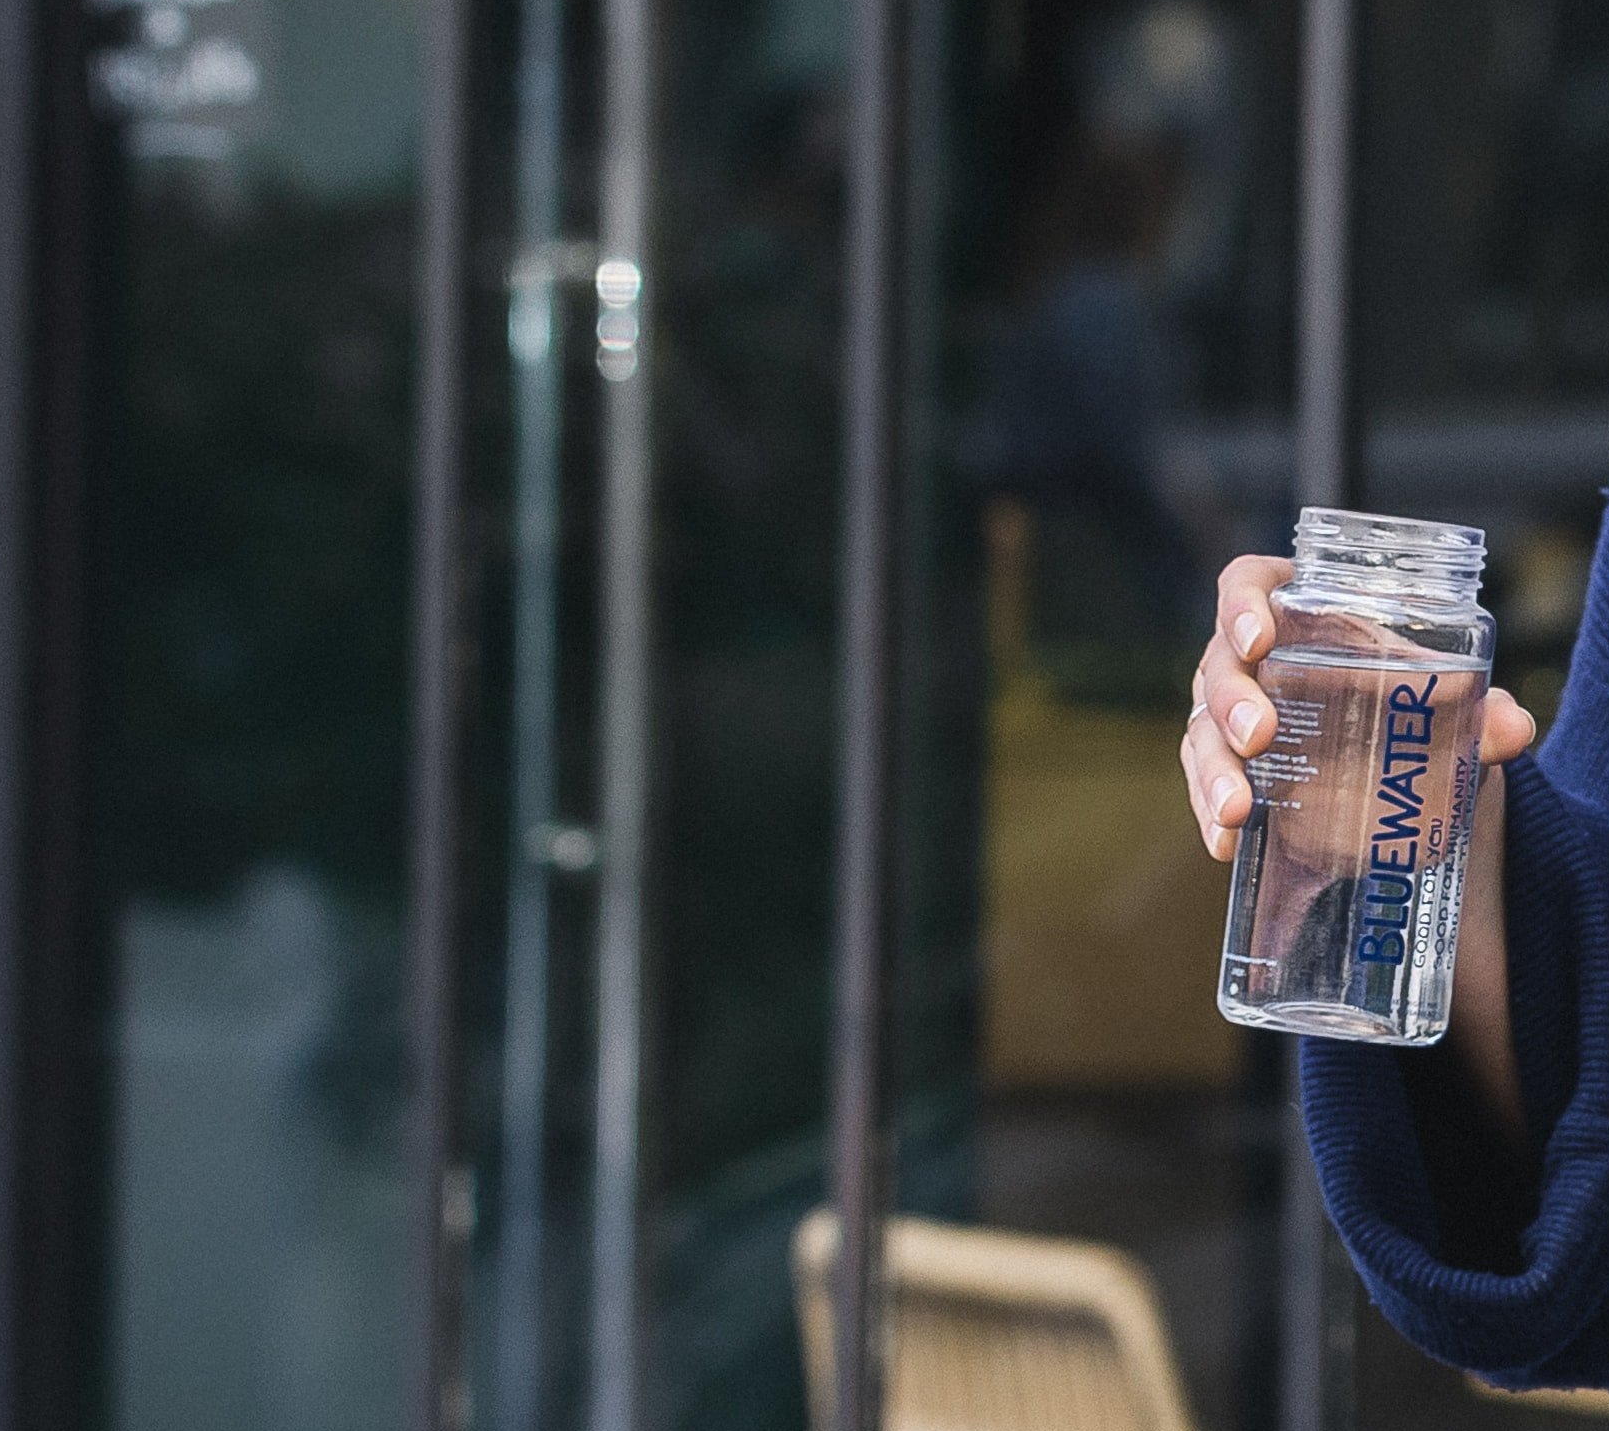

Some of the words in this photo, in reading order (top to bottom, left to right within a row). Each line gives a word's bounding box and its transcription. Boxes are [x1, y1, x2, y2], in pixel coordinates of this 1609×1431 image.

[1358, 673, 1438, 966] BLUEWATER
[1447, 756, 1468, 854] HUMANITY
[1427, 818, 1443, 859] YOU
[1422, 861, 1439, 905] FOR
[1441, 856, 1455, 901] FOR
[1414, 912, 1432, 968] GOOD
[1433, 907, 1449, 970] GOOD
